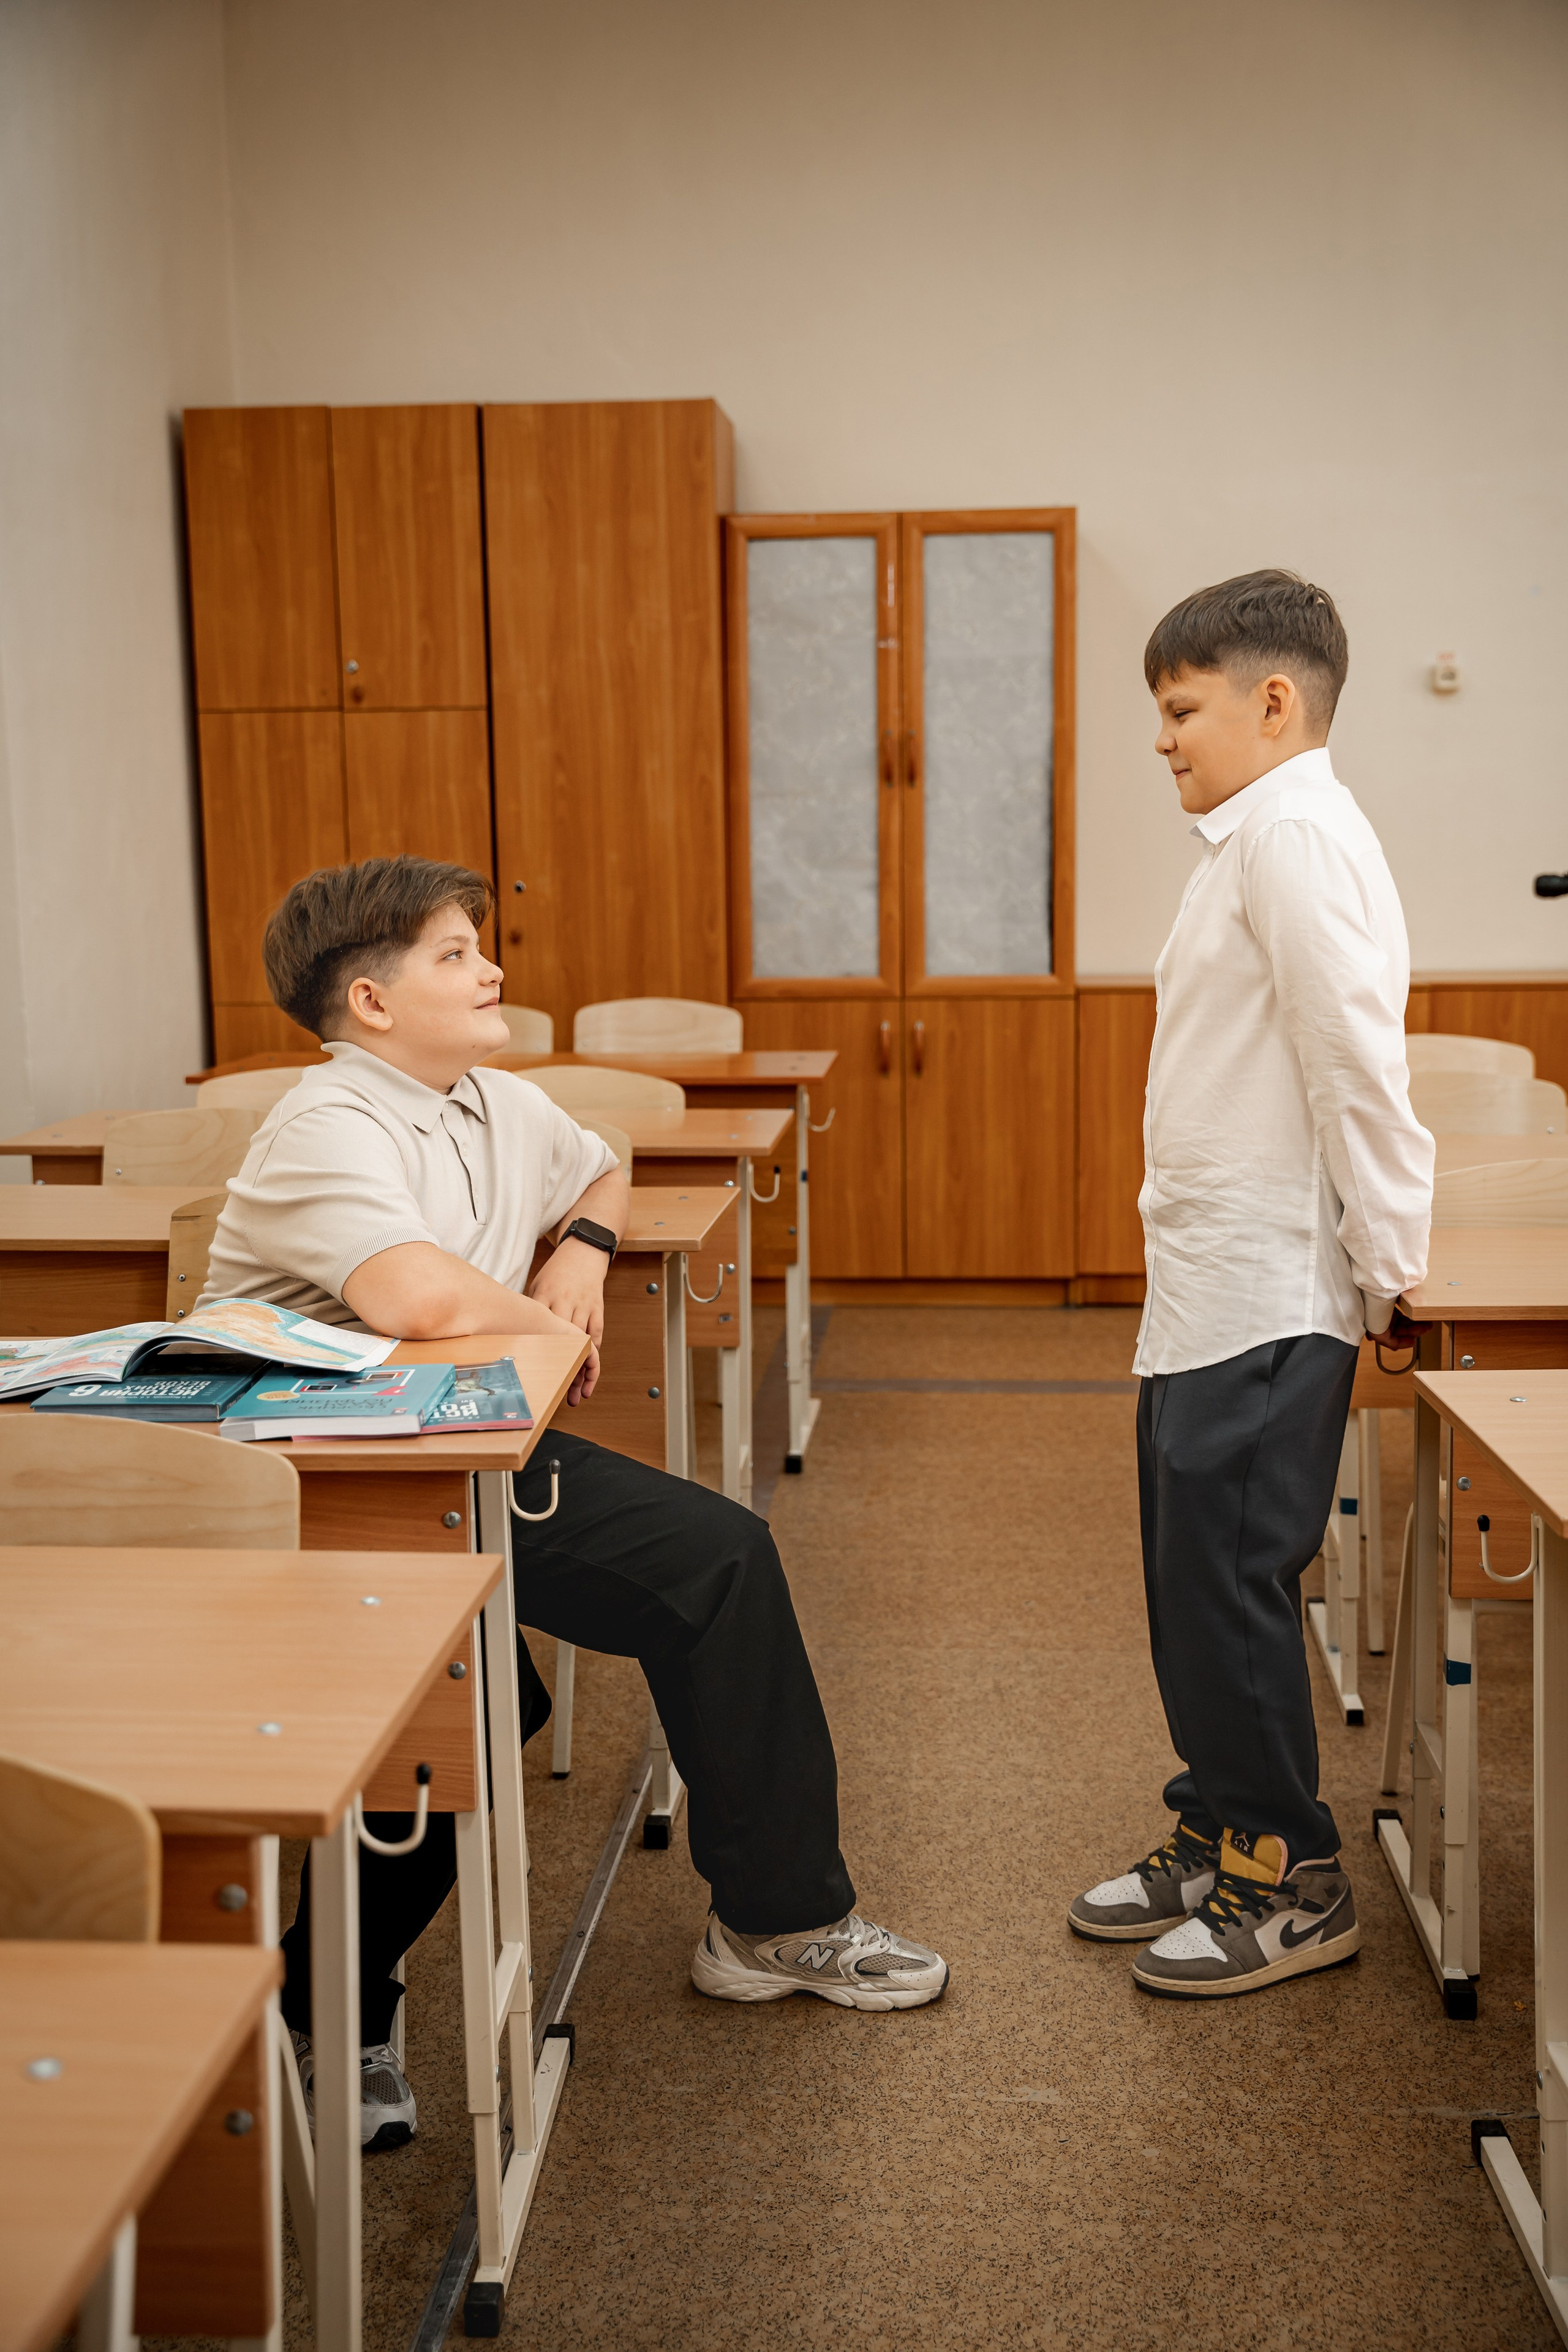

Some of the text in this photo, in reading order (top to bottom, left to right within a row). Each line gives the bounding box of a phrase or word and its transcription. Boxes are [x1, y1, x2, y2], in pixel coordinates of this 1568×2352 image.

[69, 1384, 102, 1396] 6
[440, 1401, 477, 1411] РО
[431, 1409, 478, 1419] ИСТ
[1234, 1840, 1248, 1852] AIR
[796, 1943, 835, 1970] N
